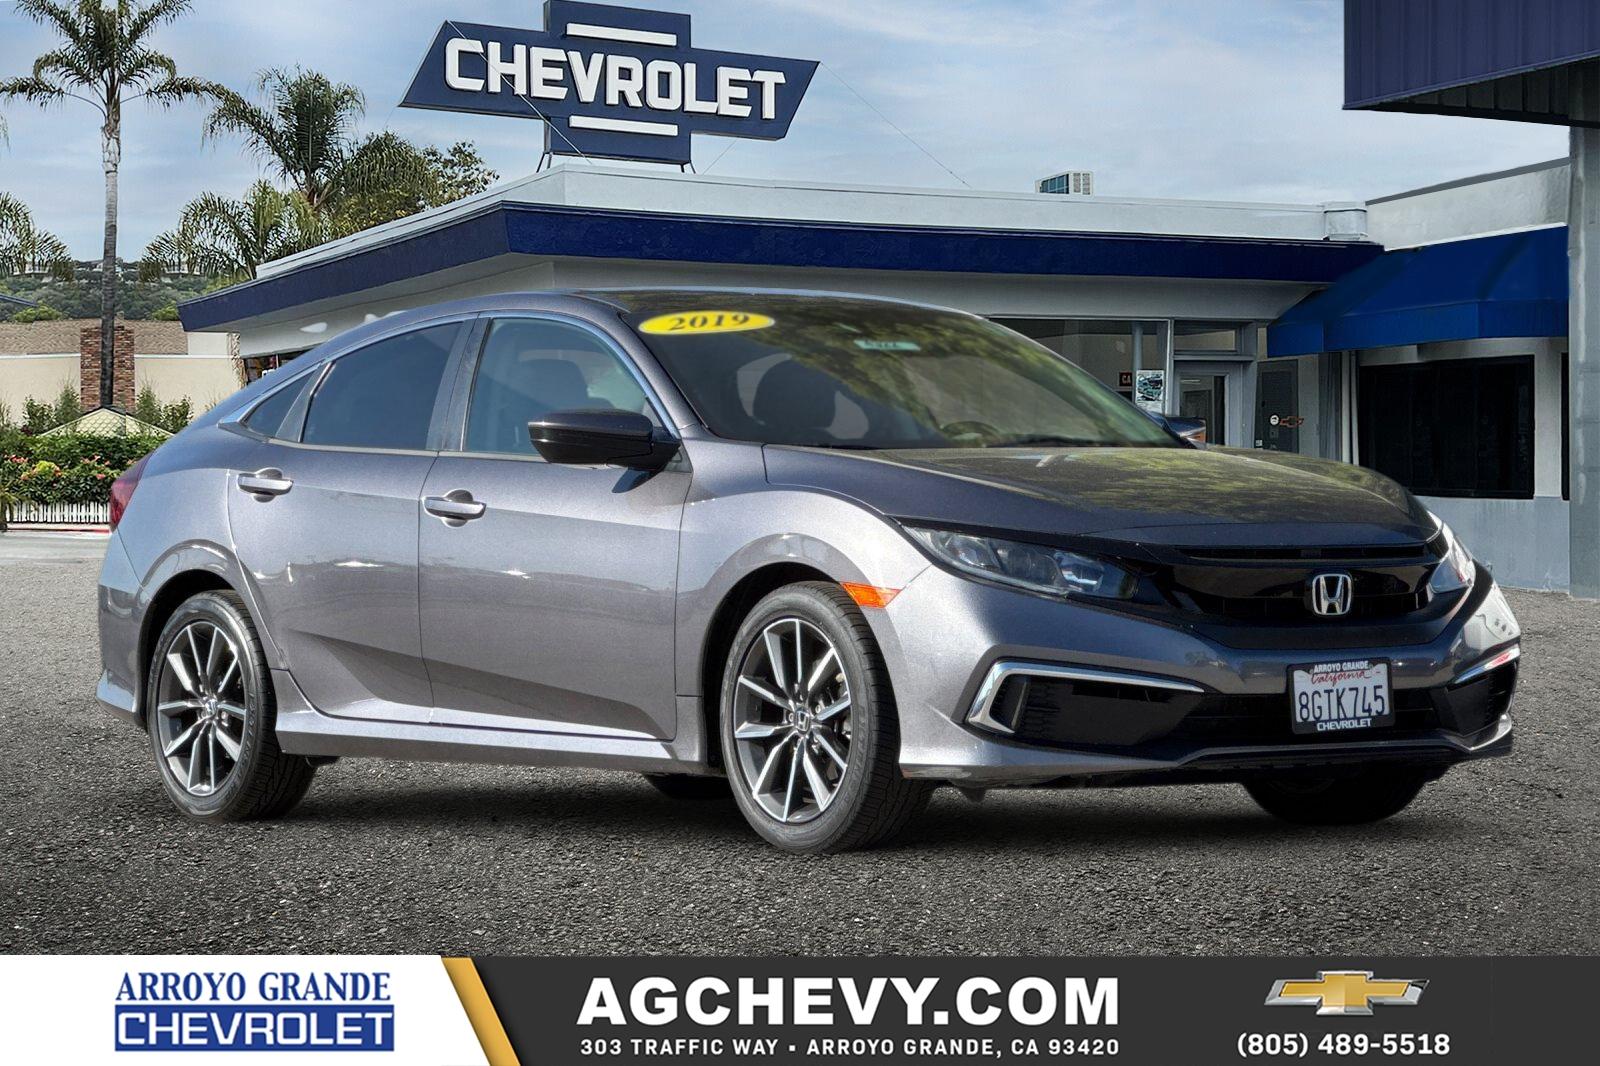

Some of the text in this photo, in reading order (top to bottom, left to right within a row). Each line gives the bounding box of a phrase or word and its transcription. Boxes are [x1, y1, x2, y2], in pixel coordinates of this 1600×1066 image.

[445, 37, 786, 119] CHEVROLET
[669, 313, 749, 330] 2019
[1314, 661, 1368, 673] ARROYO GRANDE
[1312, 670, 1372, 686] California
[1298, 685, 1385, 721] 8GTK745
[1317, 718, 1372, 731] CHEVROLET
